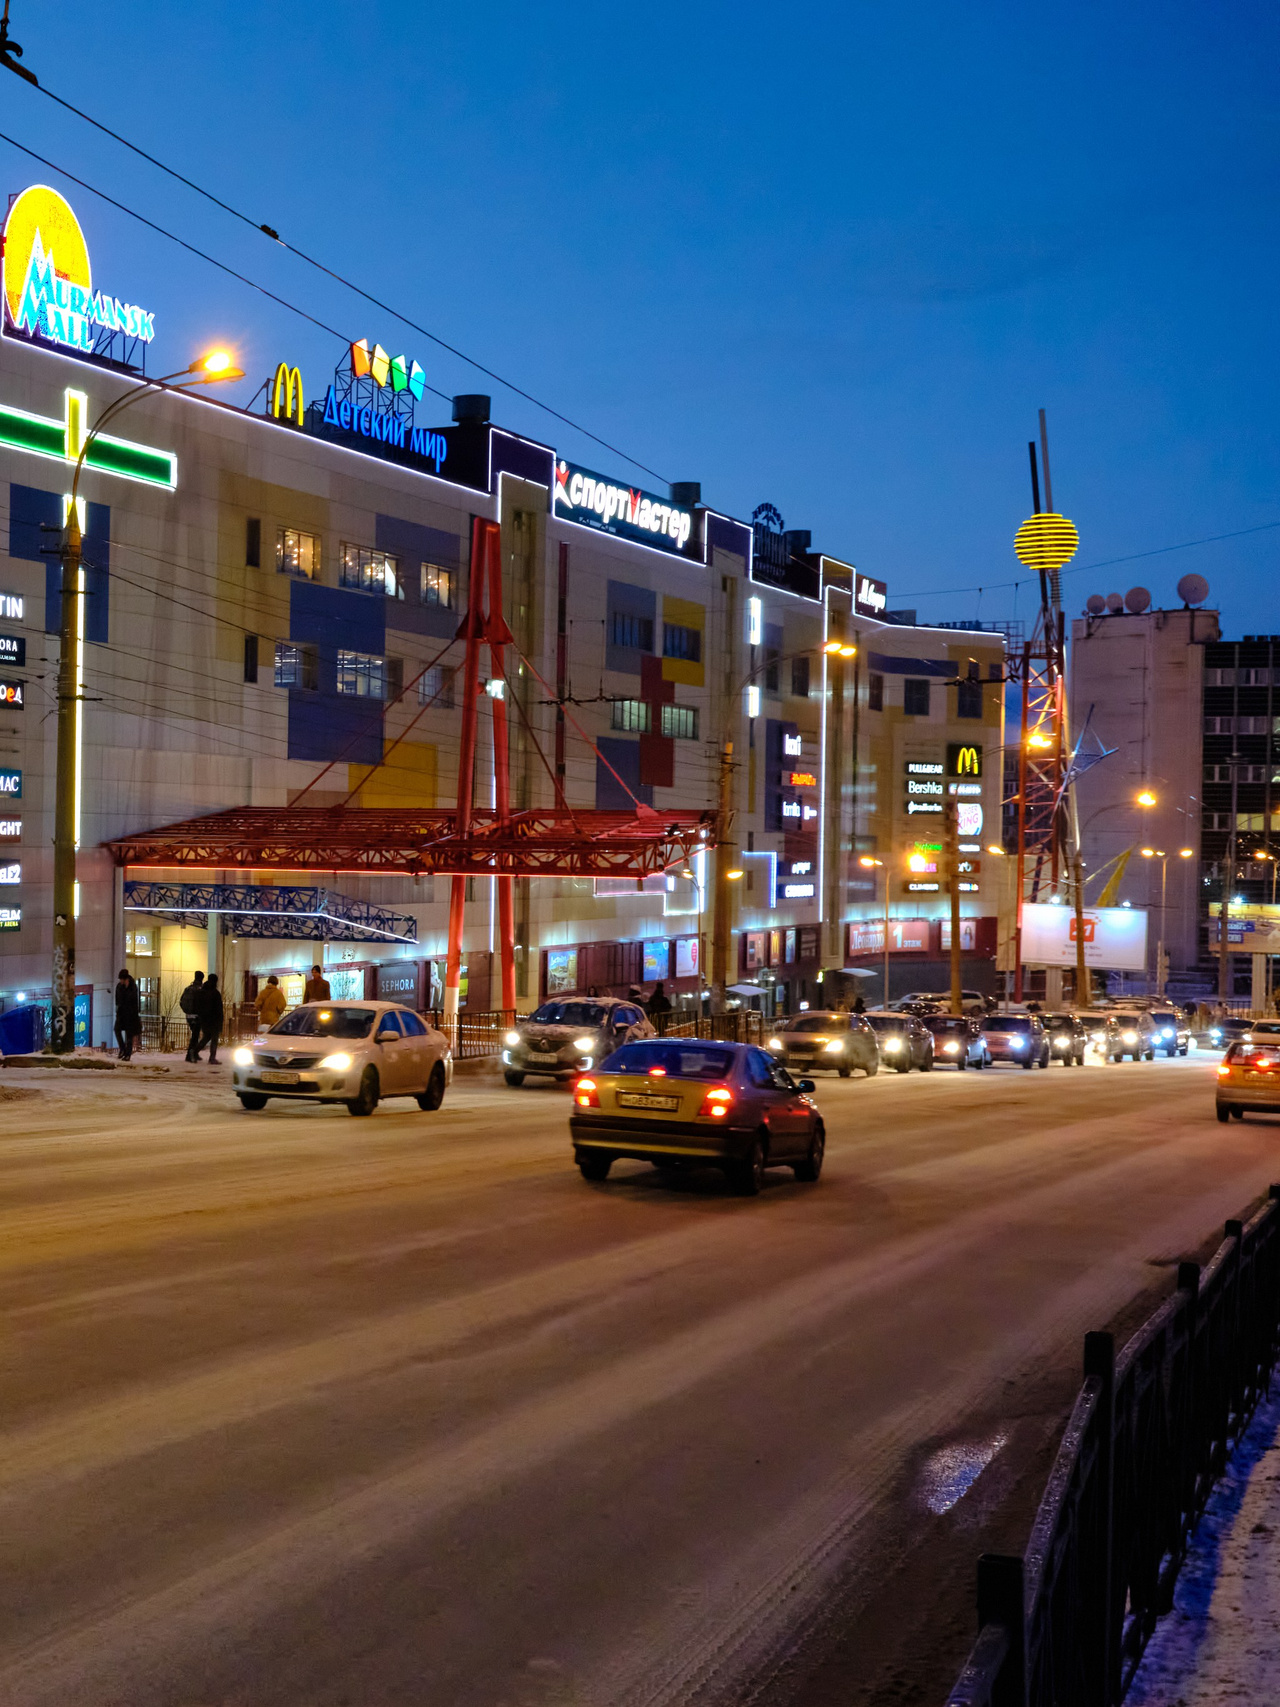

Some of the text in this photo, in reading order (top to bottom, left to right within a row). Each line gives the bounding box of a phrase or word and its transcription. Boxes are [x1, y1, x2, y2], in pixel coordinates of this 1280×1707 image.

[24, 226, 155, 344] MURMANSK
[15, 282, 94, 353] MALL
[323, 384, 447, 472] Детский мир
[908, 780, 943, 795] Bershka
[892, 924, 903, 949] 1
[381, 978, 415, 993] SEPHORA
